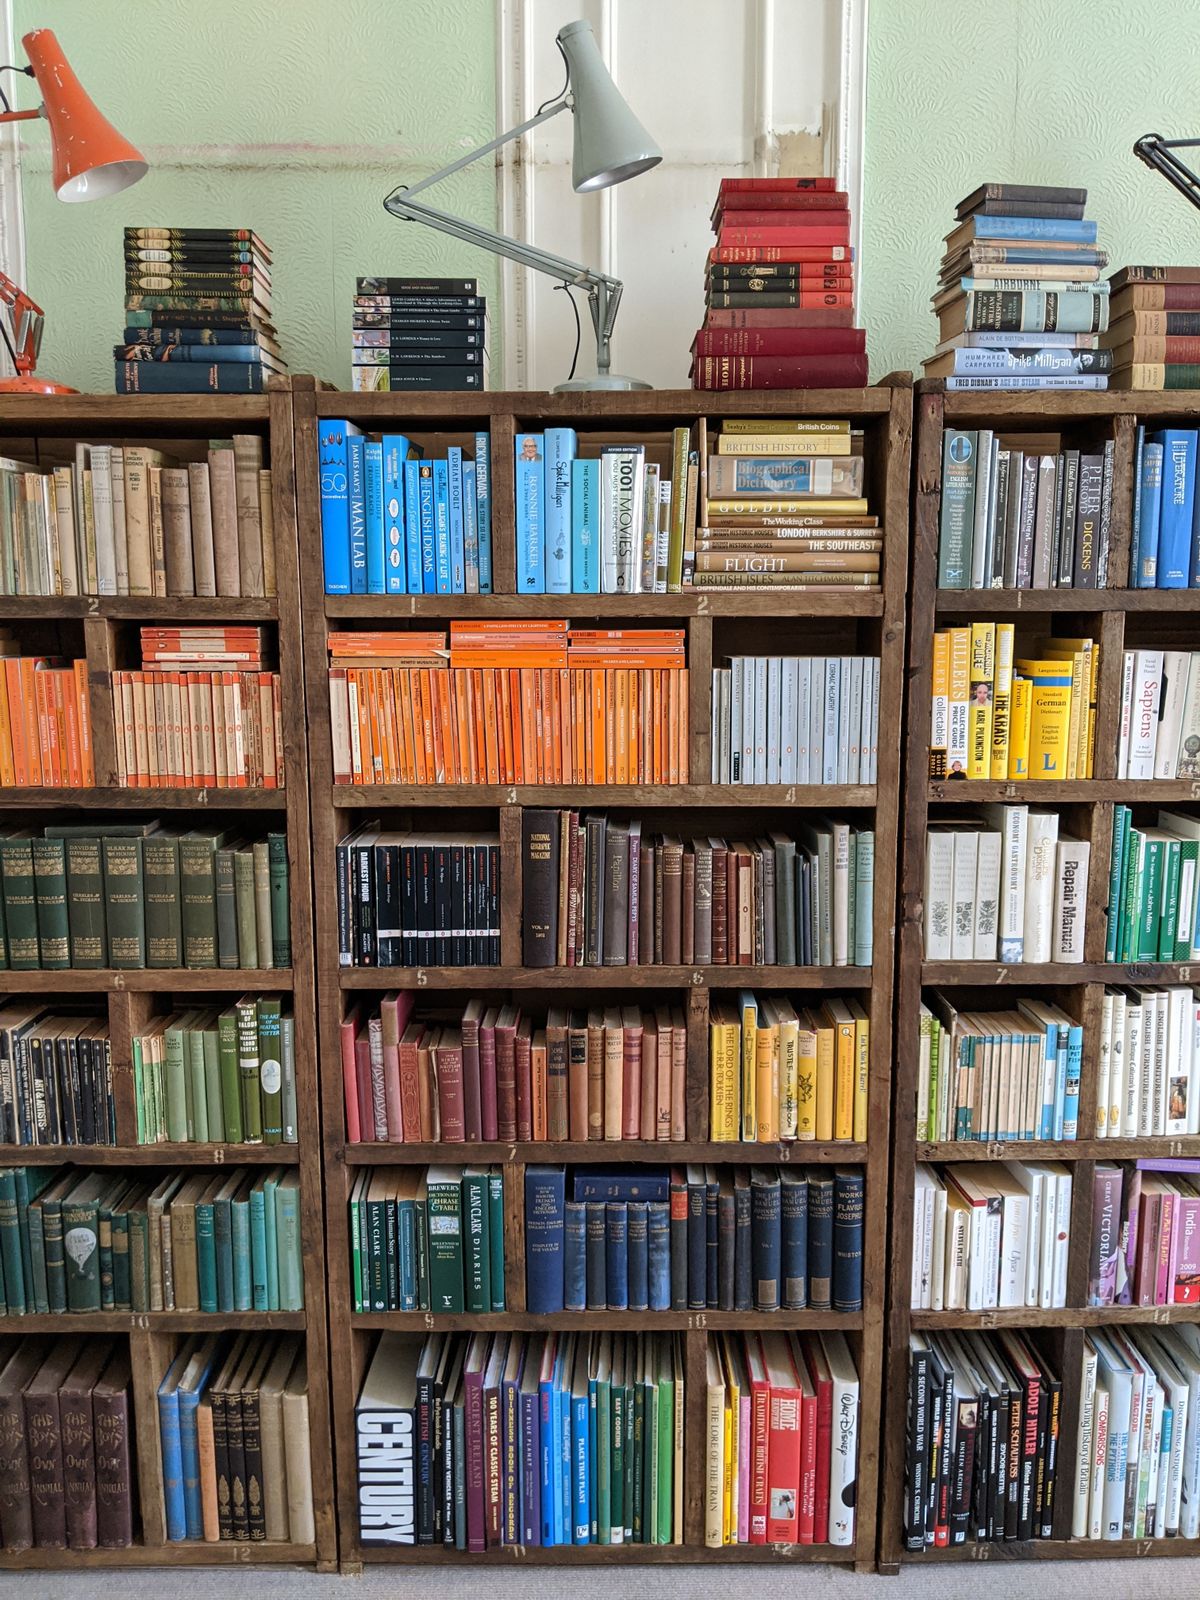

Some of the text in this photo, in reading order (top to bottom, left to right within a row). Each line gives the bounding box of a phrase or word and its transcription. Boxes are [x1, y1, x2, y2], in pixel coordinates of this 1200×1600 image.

[994, 279, 1040, 290] AIRBORNE
[1008, 355, 1071, 368] Spike Milligan
[726, 443, 818, 452] BRITISH HISTORY
[738, 460, 809, 475] Biographical
[1172, 451, 1186, 504] LITERATURE
[738, 477, 796, 488] Dictionary
[1080, 465, 1089, 514] ACKROYD
[1087, 465, 1101, 515] PETER
[352, 502, 364, 537] MAN
[619, 459, 633, 557] 1001 MOVIES
[421, 490, 433, 572] ENGLISH IDIOMS
[353, 542, 365, 568] LAB
[1082, 522, 1094, 570] DICKENS
[725, 559, 787, 571] FLIGHT
[88, 598, 99, 615] 2
[953, 632, 967, 699] MILLER'S
[1016, 684, 1024, 708] French
[1140, 680, 1157, 738] Sapiens
[936, 697, 946, 745] collectables
[994, 694, 1009, 745] THE KRAYS
[975, 710, 985, 761] KARL PILKINGTON
[507, 787, 518, 804] 3
[360, 852, 368, 882] DARKEST
[611, 855, 622, 891] Papillon
[1061, 861, 1078, 953] Repair Manual
[1146, 912, 1154, 932] Milton
[113, 975, 125, 990] 6
[416, 970, 427, 985] 5
[1, 1060, 12, 1105] HISTORICAL
[35, 1079, 44, 1092] ART
[726, 1070, 733, 1083] OF
[37, 1100, 47, 1127] ARTISTS
[725, 1102, 733, 1128] RINGS
[214, 1149, 224, 1164] 8
[507, 1145, 516, 1160] 7
[470, 1185, 480, 1207] ALAN
[470, 1208, 481, 1234] CLARK
[1185, 1210, 1197, 1236] India
[918, 1376, 926, 1404] SECOND
[1026, 1381, 1040, 1416] ADOLF
[780, 1398, 796, 1430] HOME
[916, 1406, 924, 1433] WORLD
[1132, 1392, 1140, 1433] TRACTORS
[471, 1385, 481, 1488] ANCIENT IRELAND
[490, 1436, 498, 1447] OF
[1010, 1400, 1020, 1478] PETER SCHAUFUSS
[1025, 1419, 1037, 1455] HITLER
[1079, 1361, 1095, 1495] The Living History of Britain
[1096, 1410, 1108, 1466] COMPARISONS
[710, 1450, 718, 1462] OF
[756, 1392, 766, 1504] TRADITIONAL BRITISH CRAFTS
[1107, 1432, 1118, 1482] THE PYTHONS
[358, 1413, 414, 1544] CENTURY
[710, 1464, 718, 1482] THE
[956, 1469, 964, 1500] ARCHIVES
[1023, 1461, 1032, 1484] Editions
[710, 1483, 718, 1512] TRAIN
[232, 1547, 250, 1561] 12
